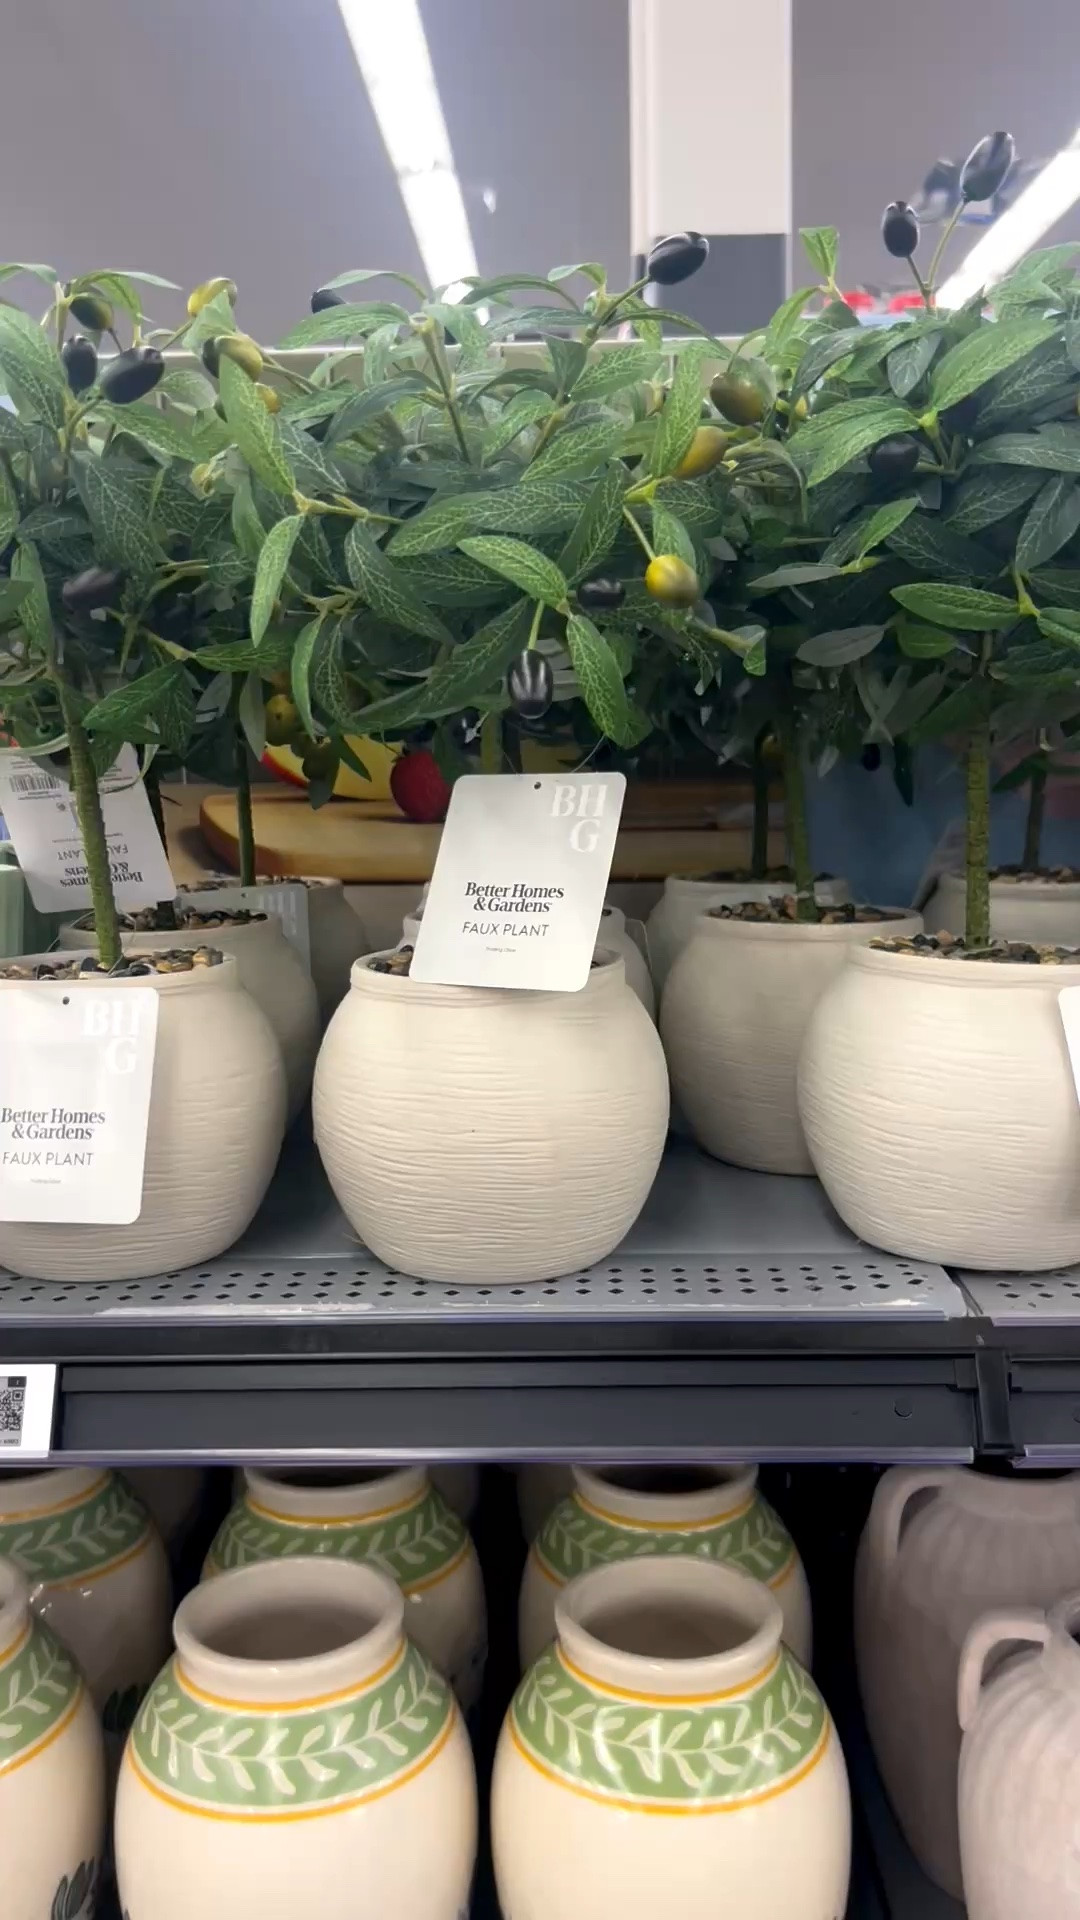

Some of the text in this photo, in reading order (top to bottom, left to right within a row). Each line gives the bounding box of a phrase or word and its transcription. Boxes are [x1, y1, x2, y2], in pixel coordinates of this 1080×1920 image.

[551, 784, 609, 817] BH
[569, 818, 602, 852] G
[465, 881, 565, 899] Better Homes
[462, 921, 550, 937] FAUX PLANT
[1, 1107, 106, 1125] Better Homes
[2, 1151, 94, 1166] FAUX PLANT
